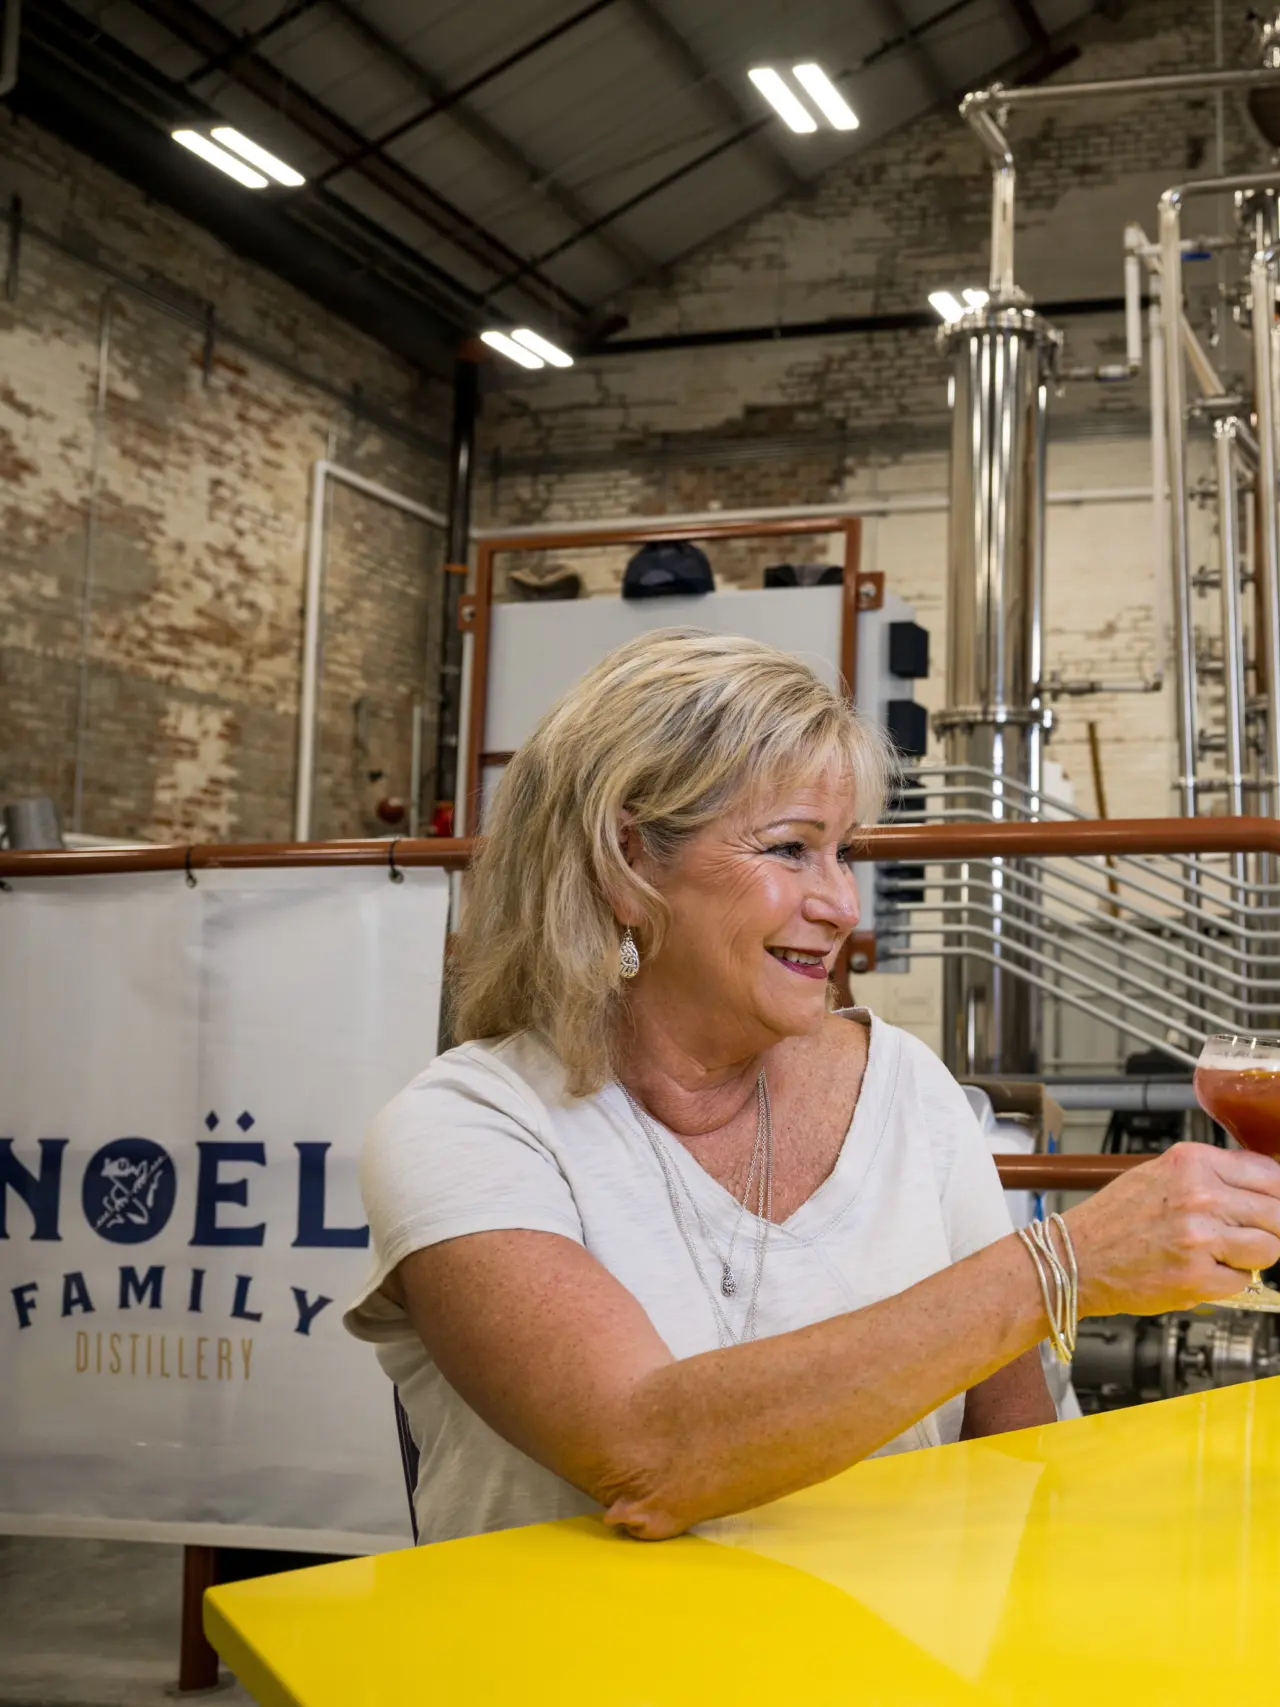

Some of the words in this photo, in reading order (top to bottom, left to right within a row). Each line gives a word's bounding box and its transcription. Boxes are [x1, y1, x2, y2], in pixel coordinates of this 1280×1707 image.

[0, 1110, 370, 1248] NOËL
[11, 1265, 334, 1336] FAMILY
[75, 1331, 254, 1380] DISTILLERY
